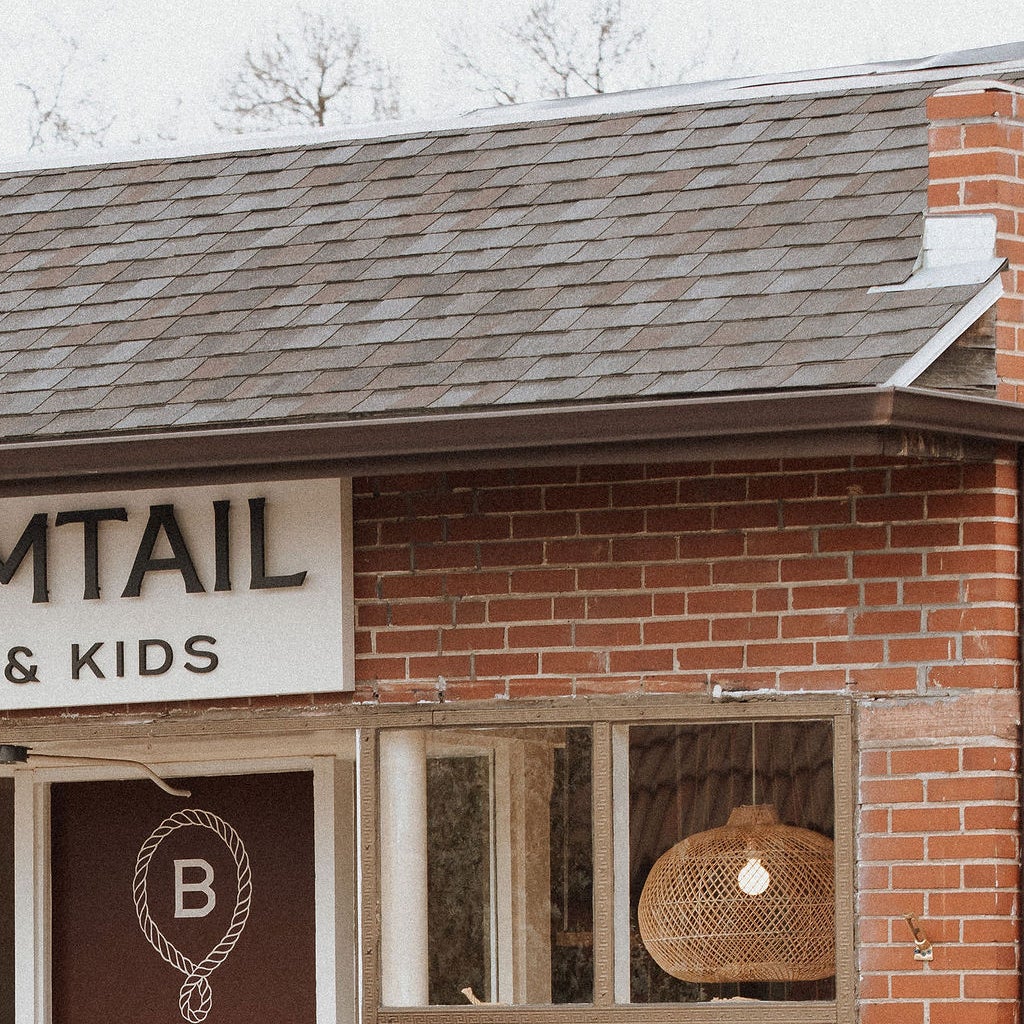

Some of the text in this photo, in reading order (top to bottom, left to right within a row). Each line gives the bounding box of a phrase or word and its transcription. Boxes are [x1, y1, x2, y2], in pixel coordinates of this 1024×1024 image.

[4, 645, 39, 684] &
[71, 633, 221, 681] KIDS
[173, 858, 216, 918] B
